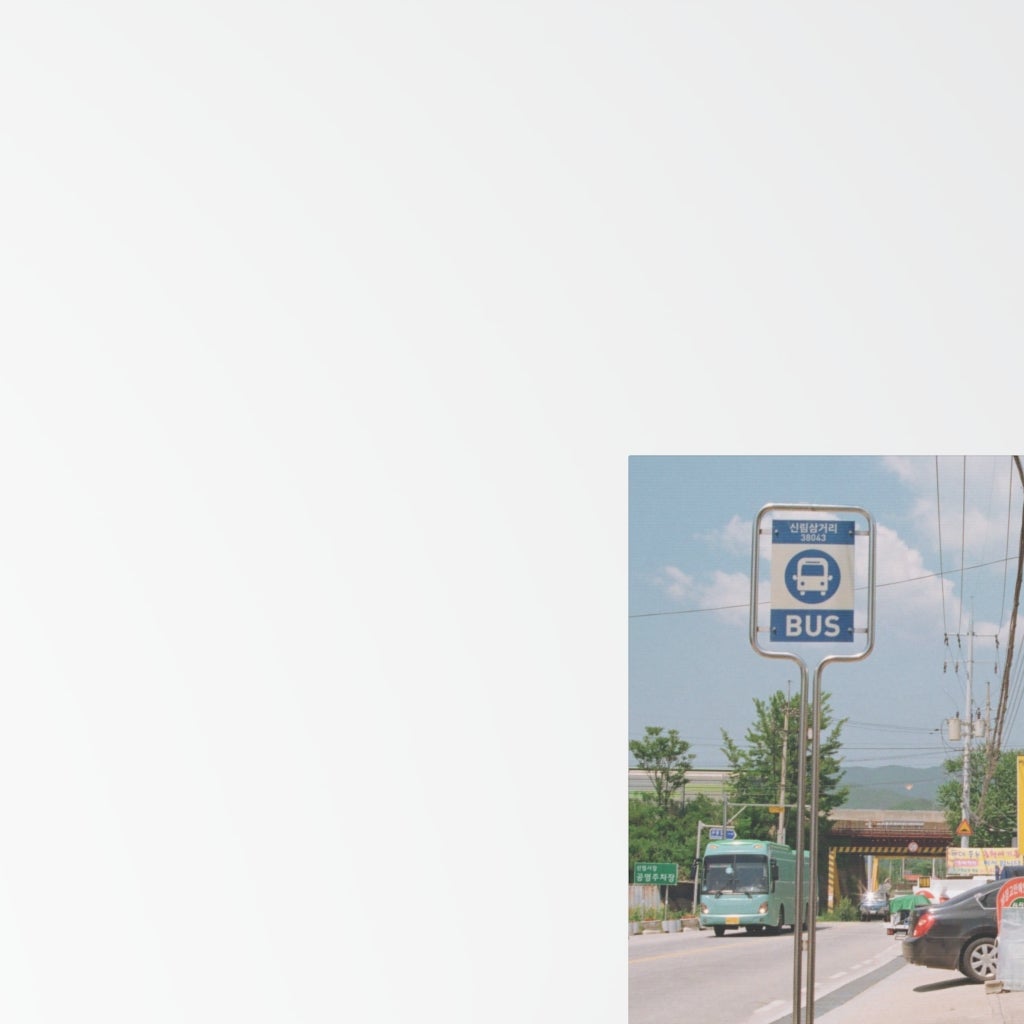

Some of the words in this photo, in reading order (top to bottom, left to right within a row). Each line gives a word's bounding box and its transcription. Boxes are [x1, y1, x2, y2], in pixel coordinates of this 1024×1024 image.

[789, 522, 838, 534] 신림삼거리
[800, 533, 827, 542] 38043
[785, 614, 841, 637] BUS
